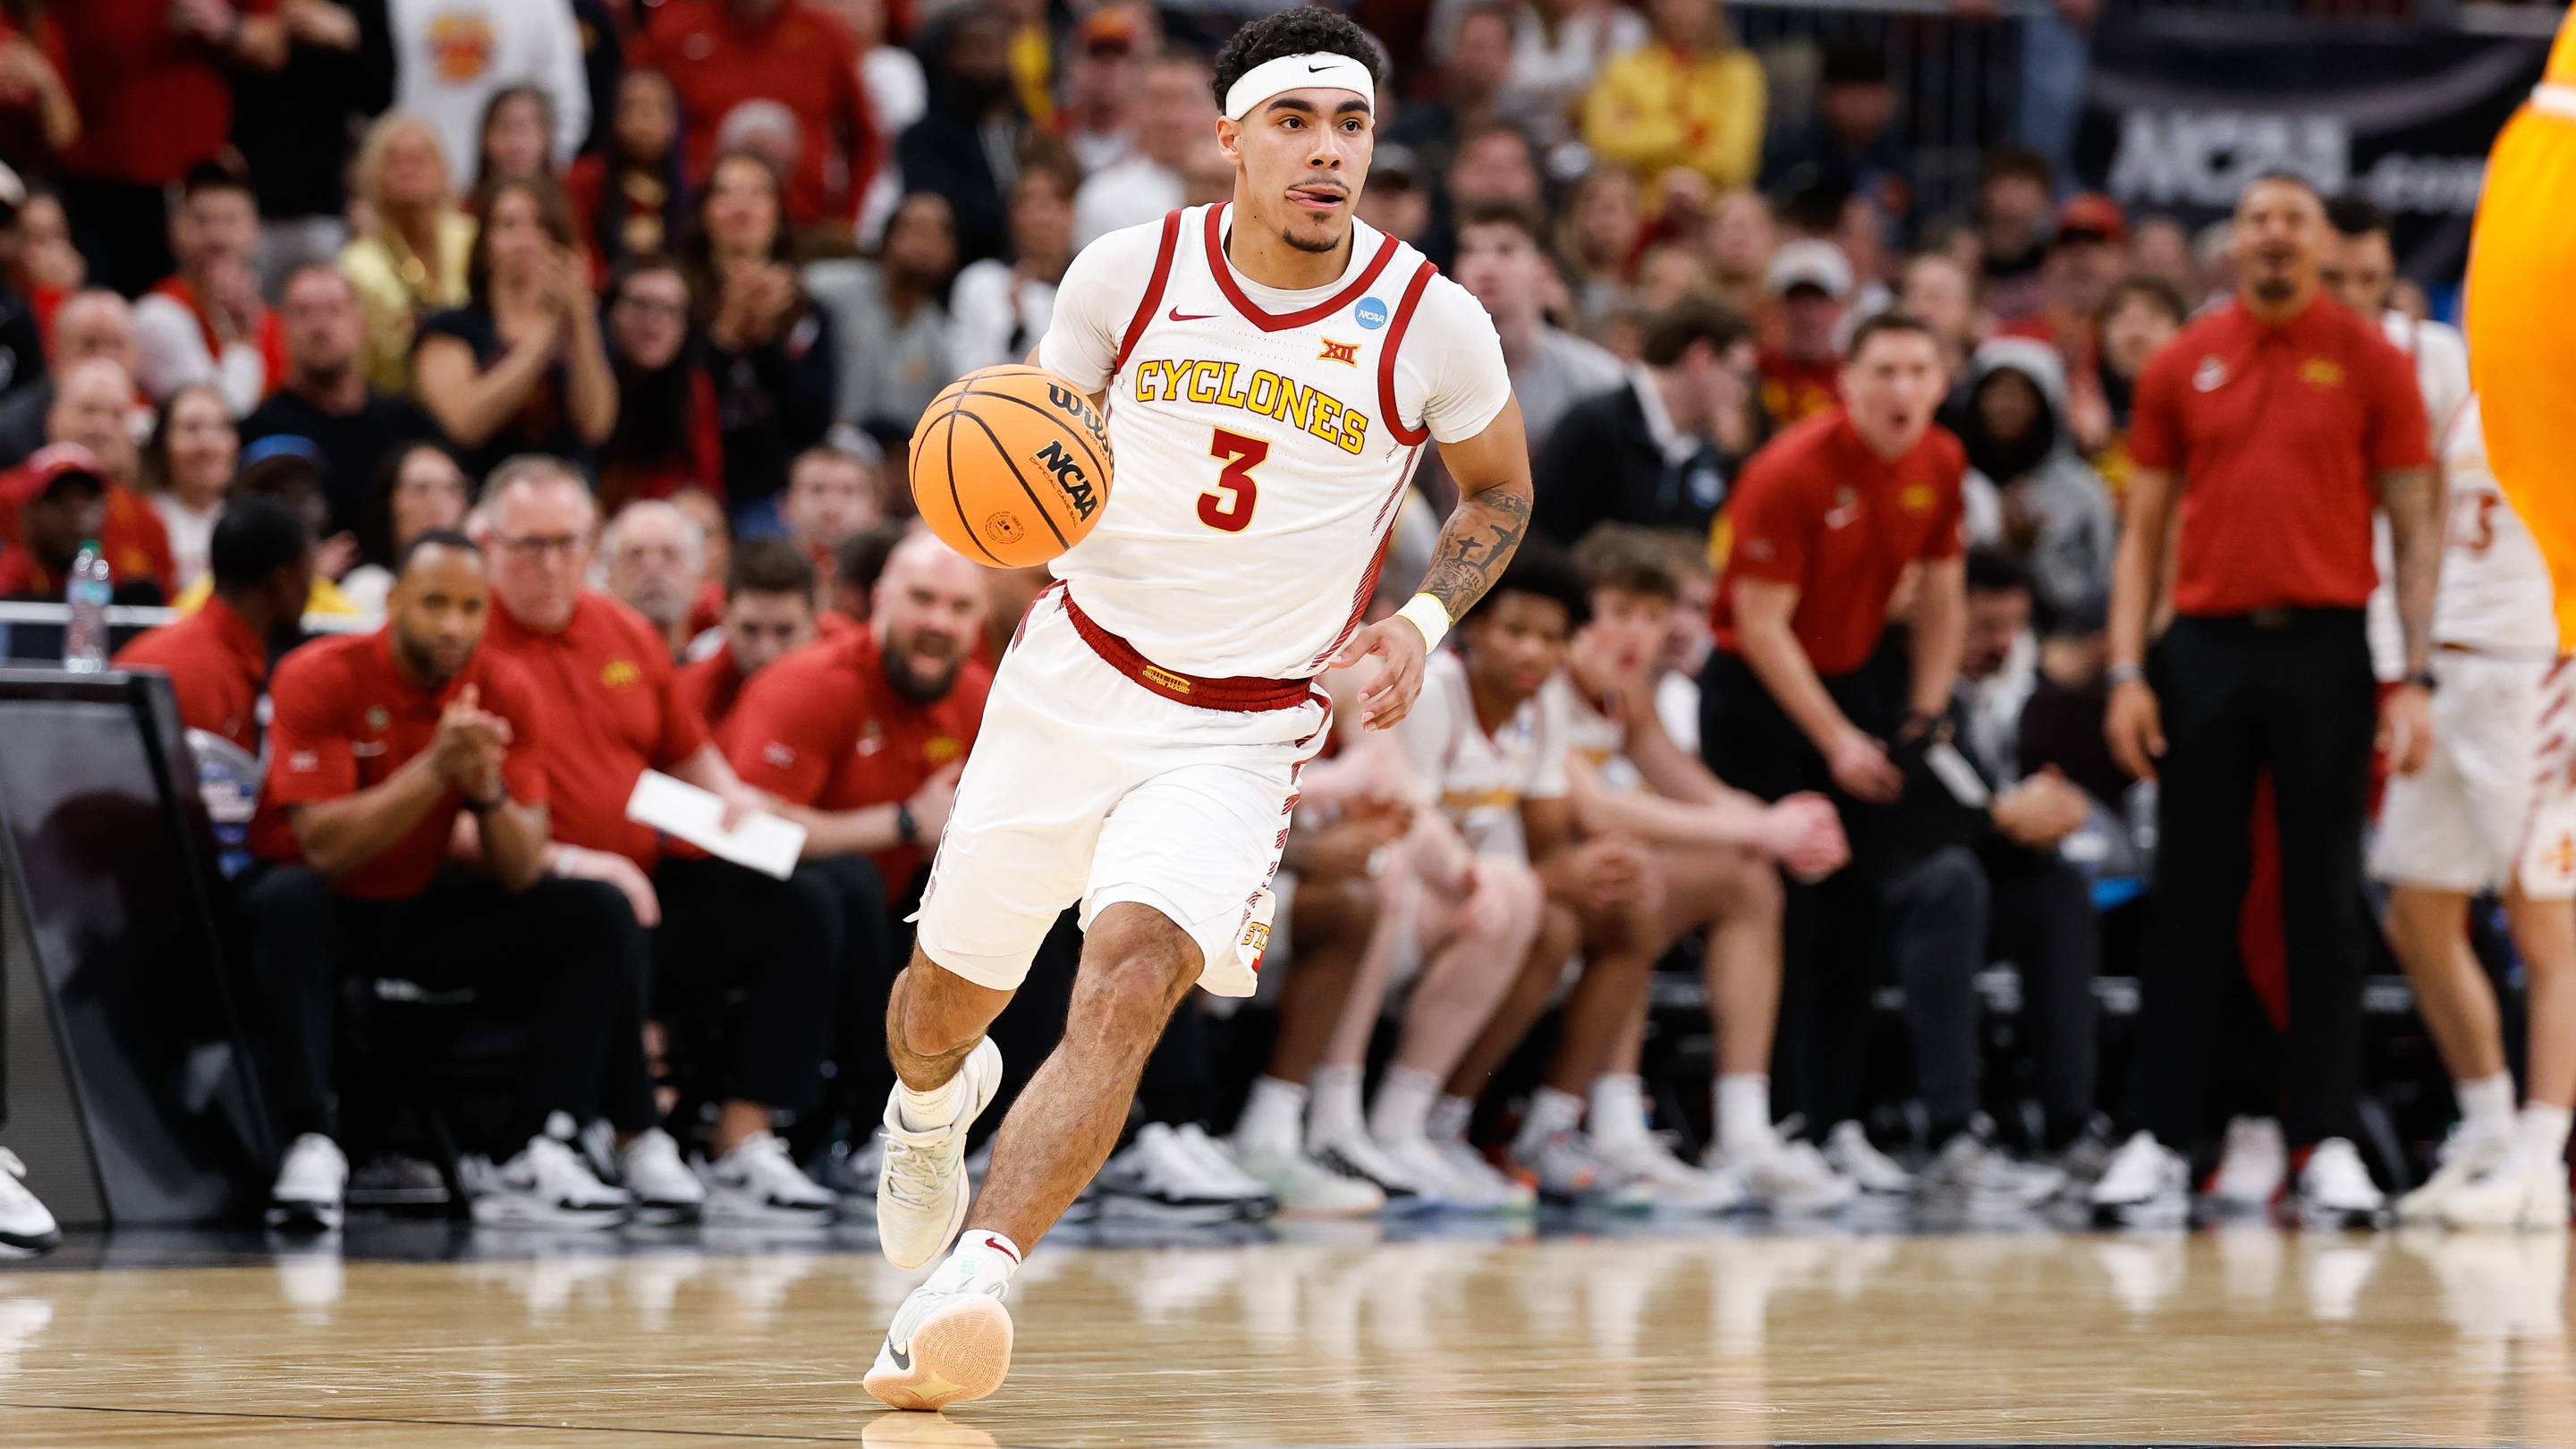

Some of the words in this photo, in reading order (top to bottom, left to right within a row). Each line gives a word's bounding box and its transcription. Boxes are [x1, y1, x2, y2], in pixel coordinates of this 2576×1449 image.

[1359, 309, 1385, 323] NCAA
[1318, 337, 1361, 368] XII
[1135, 360, 1369, 455] CYCLONES
[1029, 456, 1056, 490] OFFICIAL
[1036, 439, 1098, 523] NCAA
[1195, 426, 1272, 533] 3
[1142, 670, 1166, 687] HILTON
[1166, 682, 1191, 695] MAGIC
